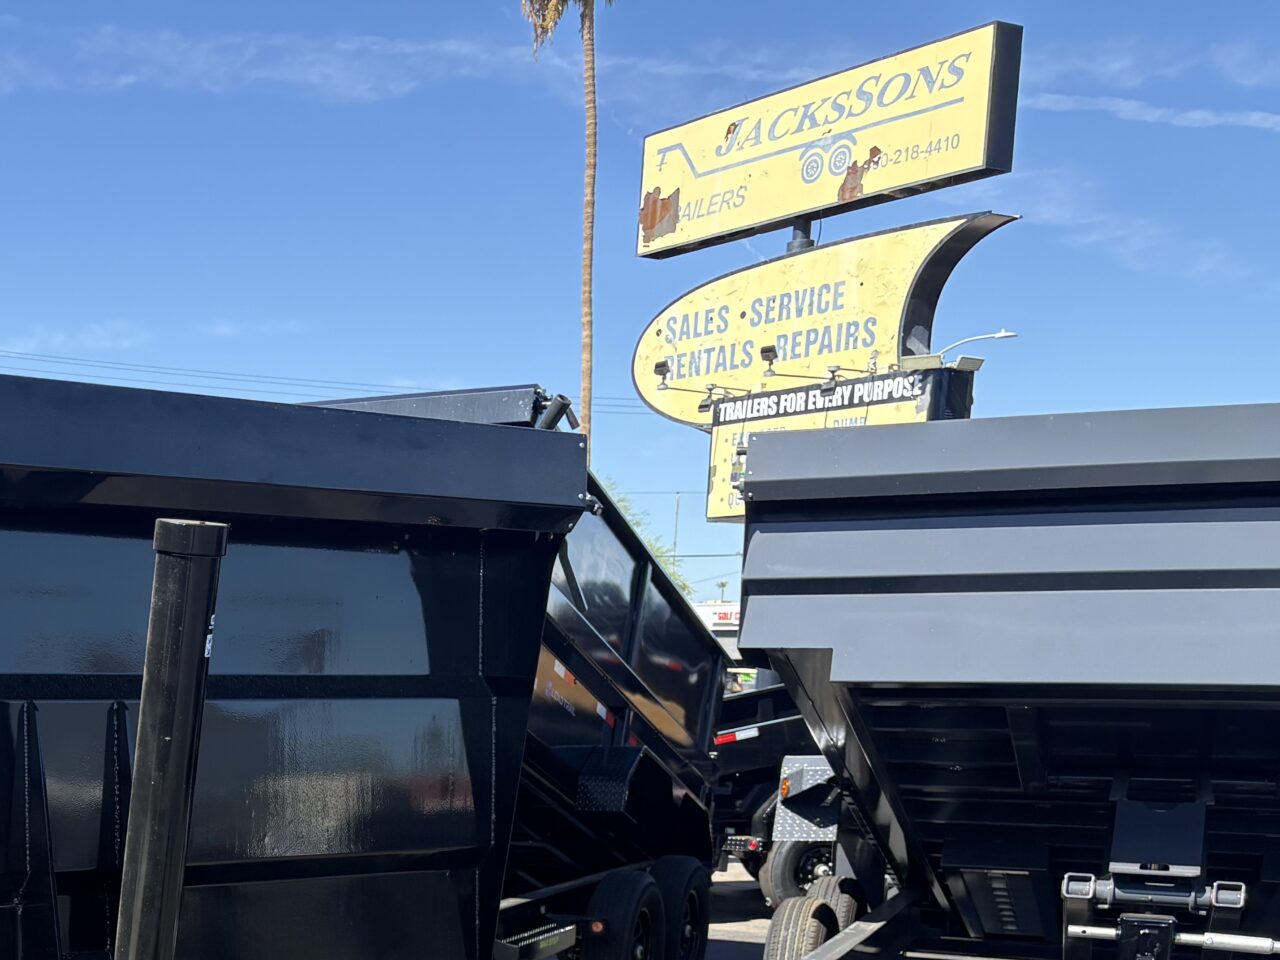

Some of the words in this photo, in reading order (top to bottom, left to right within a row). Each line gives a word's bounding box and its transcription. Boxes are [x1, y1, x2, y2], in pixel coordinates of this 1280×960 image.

[863, 133, 961, 170] 0-218-4410
[678, 185, 748, 223] AILERS
[665, 305, 730, 344] SALES
[749, 280, 846, 328] SERVICE
[663, 339, 754, 380] RENTALS
[776, 316, 877, 362] REPAIRS
[719, 395, 778, 422] TRAILERS
[779, 391, 806, 413] FOR
[853, 374, 923, 404] PURPOSE
